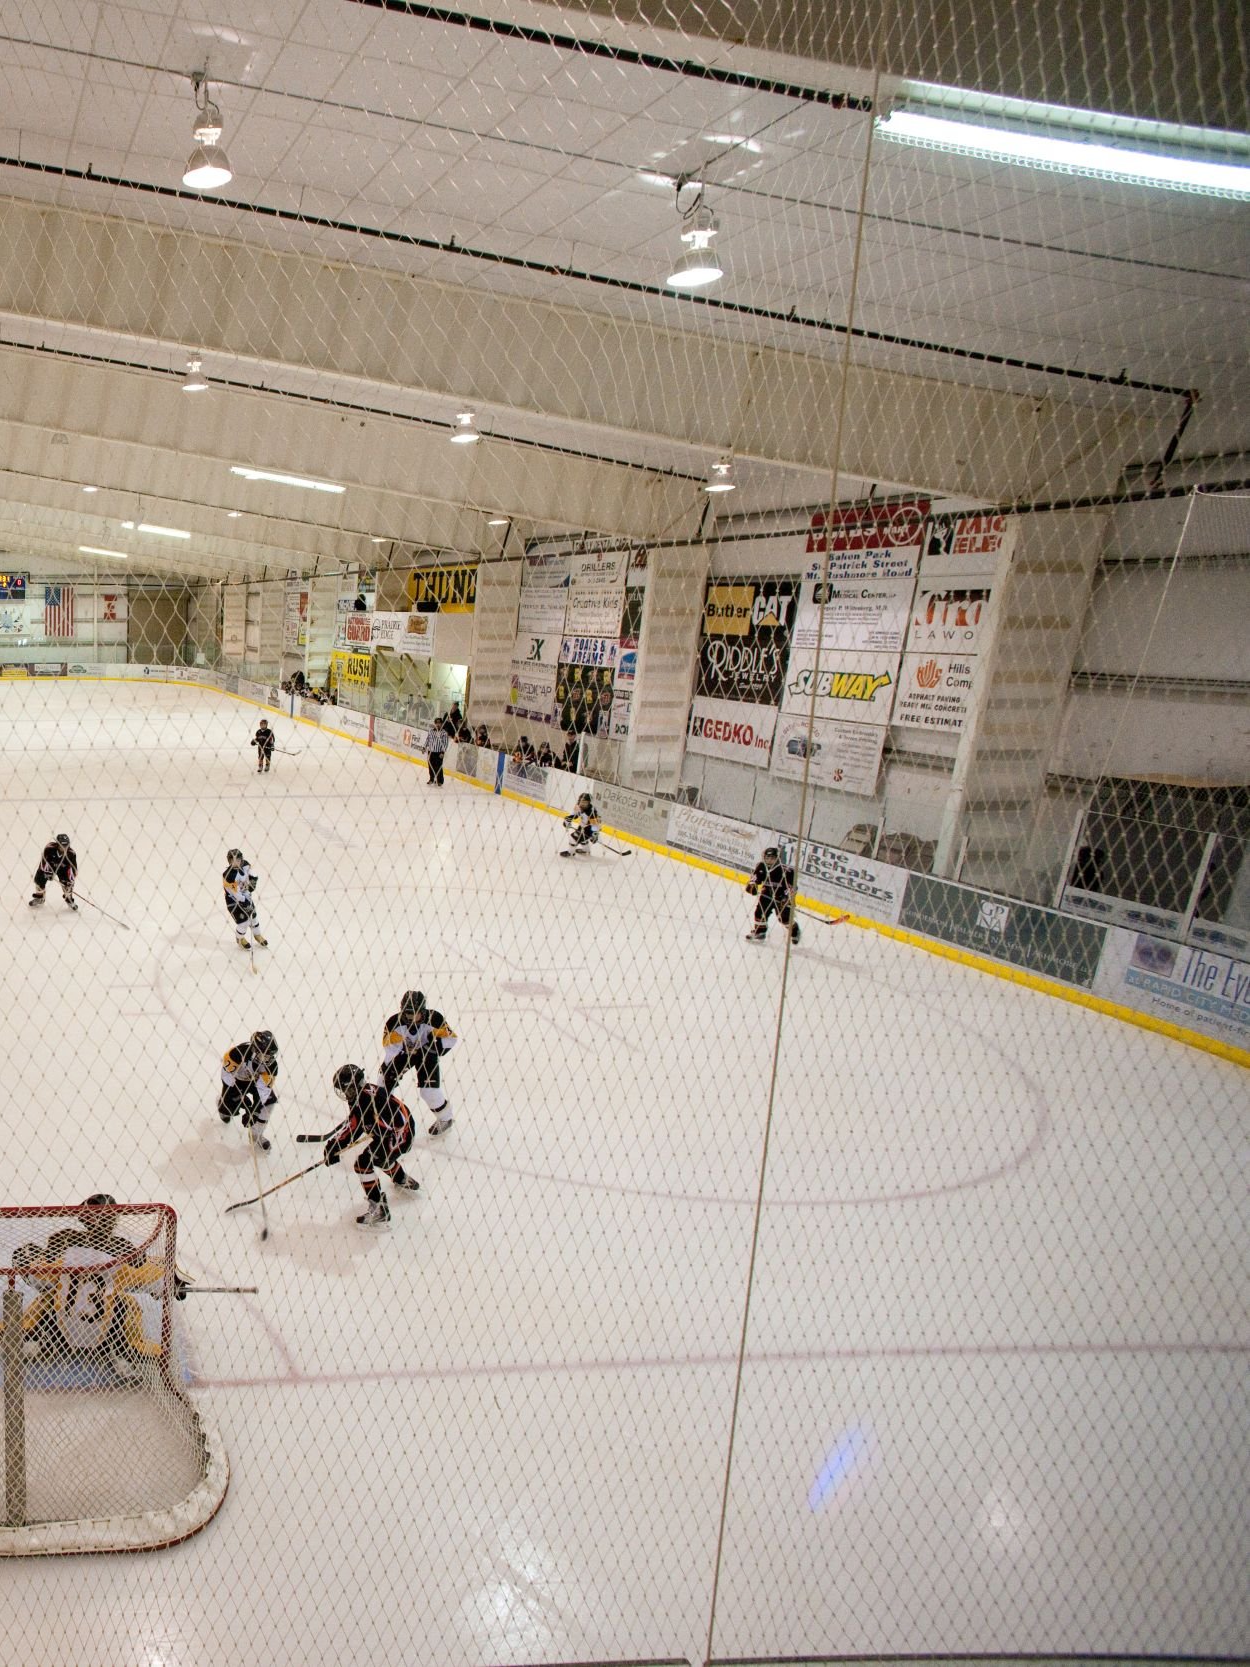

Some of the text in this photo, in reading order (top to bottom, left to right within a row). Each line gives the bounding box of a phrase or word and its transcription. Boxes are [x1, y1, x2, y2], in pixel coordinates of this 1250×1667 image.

[953, 535, 1002, 555] ELE
[581, 562, 616, 572] DRILLERS
[830, 561, 868, 571] Patrick
[872, 560, 908, 569] Street
[805, 572, 821, 580] Mt.
[573, 598, 601, 609] Creative
[707, 603, 750, 618] Butler
[751, 594, 793, 626] CAT
[347, 625, 370, 642] GUARD
[573, 638, 599, 652] GOALS
[347, 658, 370, 677] RUSH
[707, 640, 780, 681] RIDDLE'S
[948, 663, 971, 674] Hills
[729, 671, 776, 683] JEWELRY
[788, 669, 892, 702] SUBWAY
[937, 695, 961, 703] PAVING
[900, 714, 922, 723] FREE
[703, 718, 754, 747] GEDKO
[603, 788, 638, 808] Dakota
[677, 808, 731, 833] Pioneer
[812, 845, 849, 863] The
[808, 854, 876, 883] Rehab
[806, 864, 894, 900] Doctors
[1182, 948, 1219, 991] The
[1144, 978, 1183, 998] RAPID
[1151, 996, 1181, 1013] Home
[1184, 1008, 1195, 1017] of
